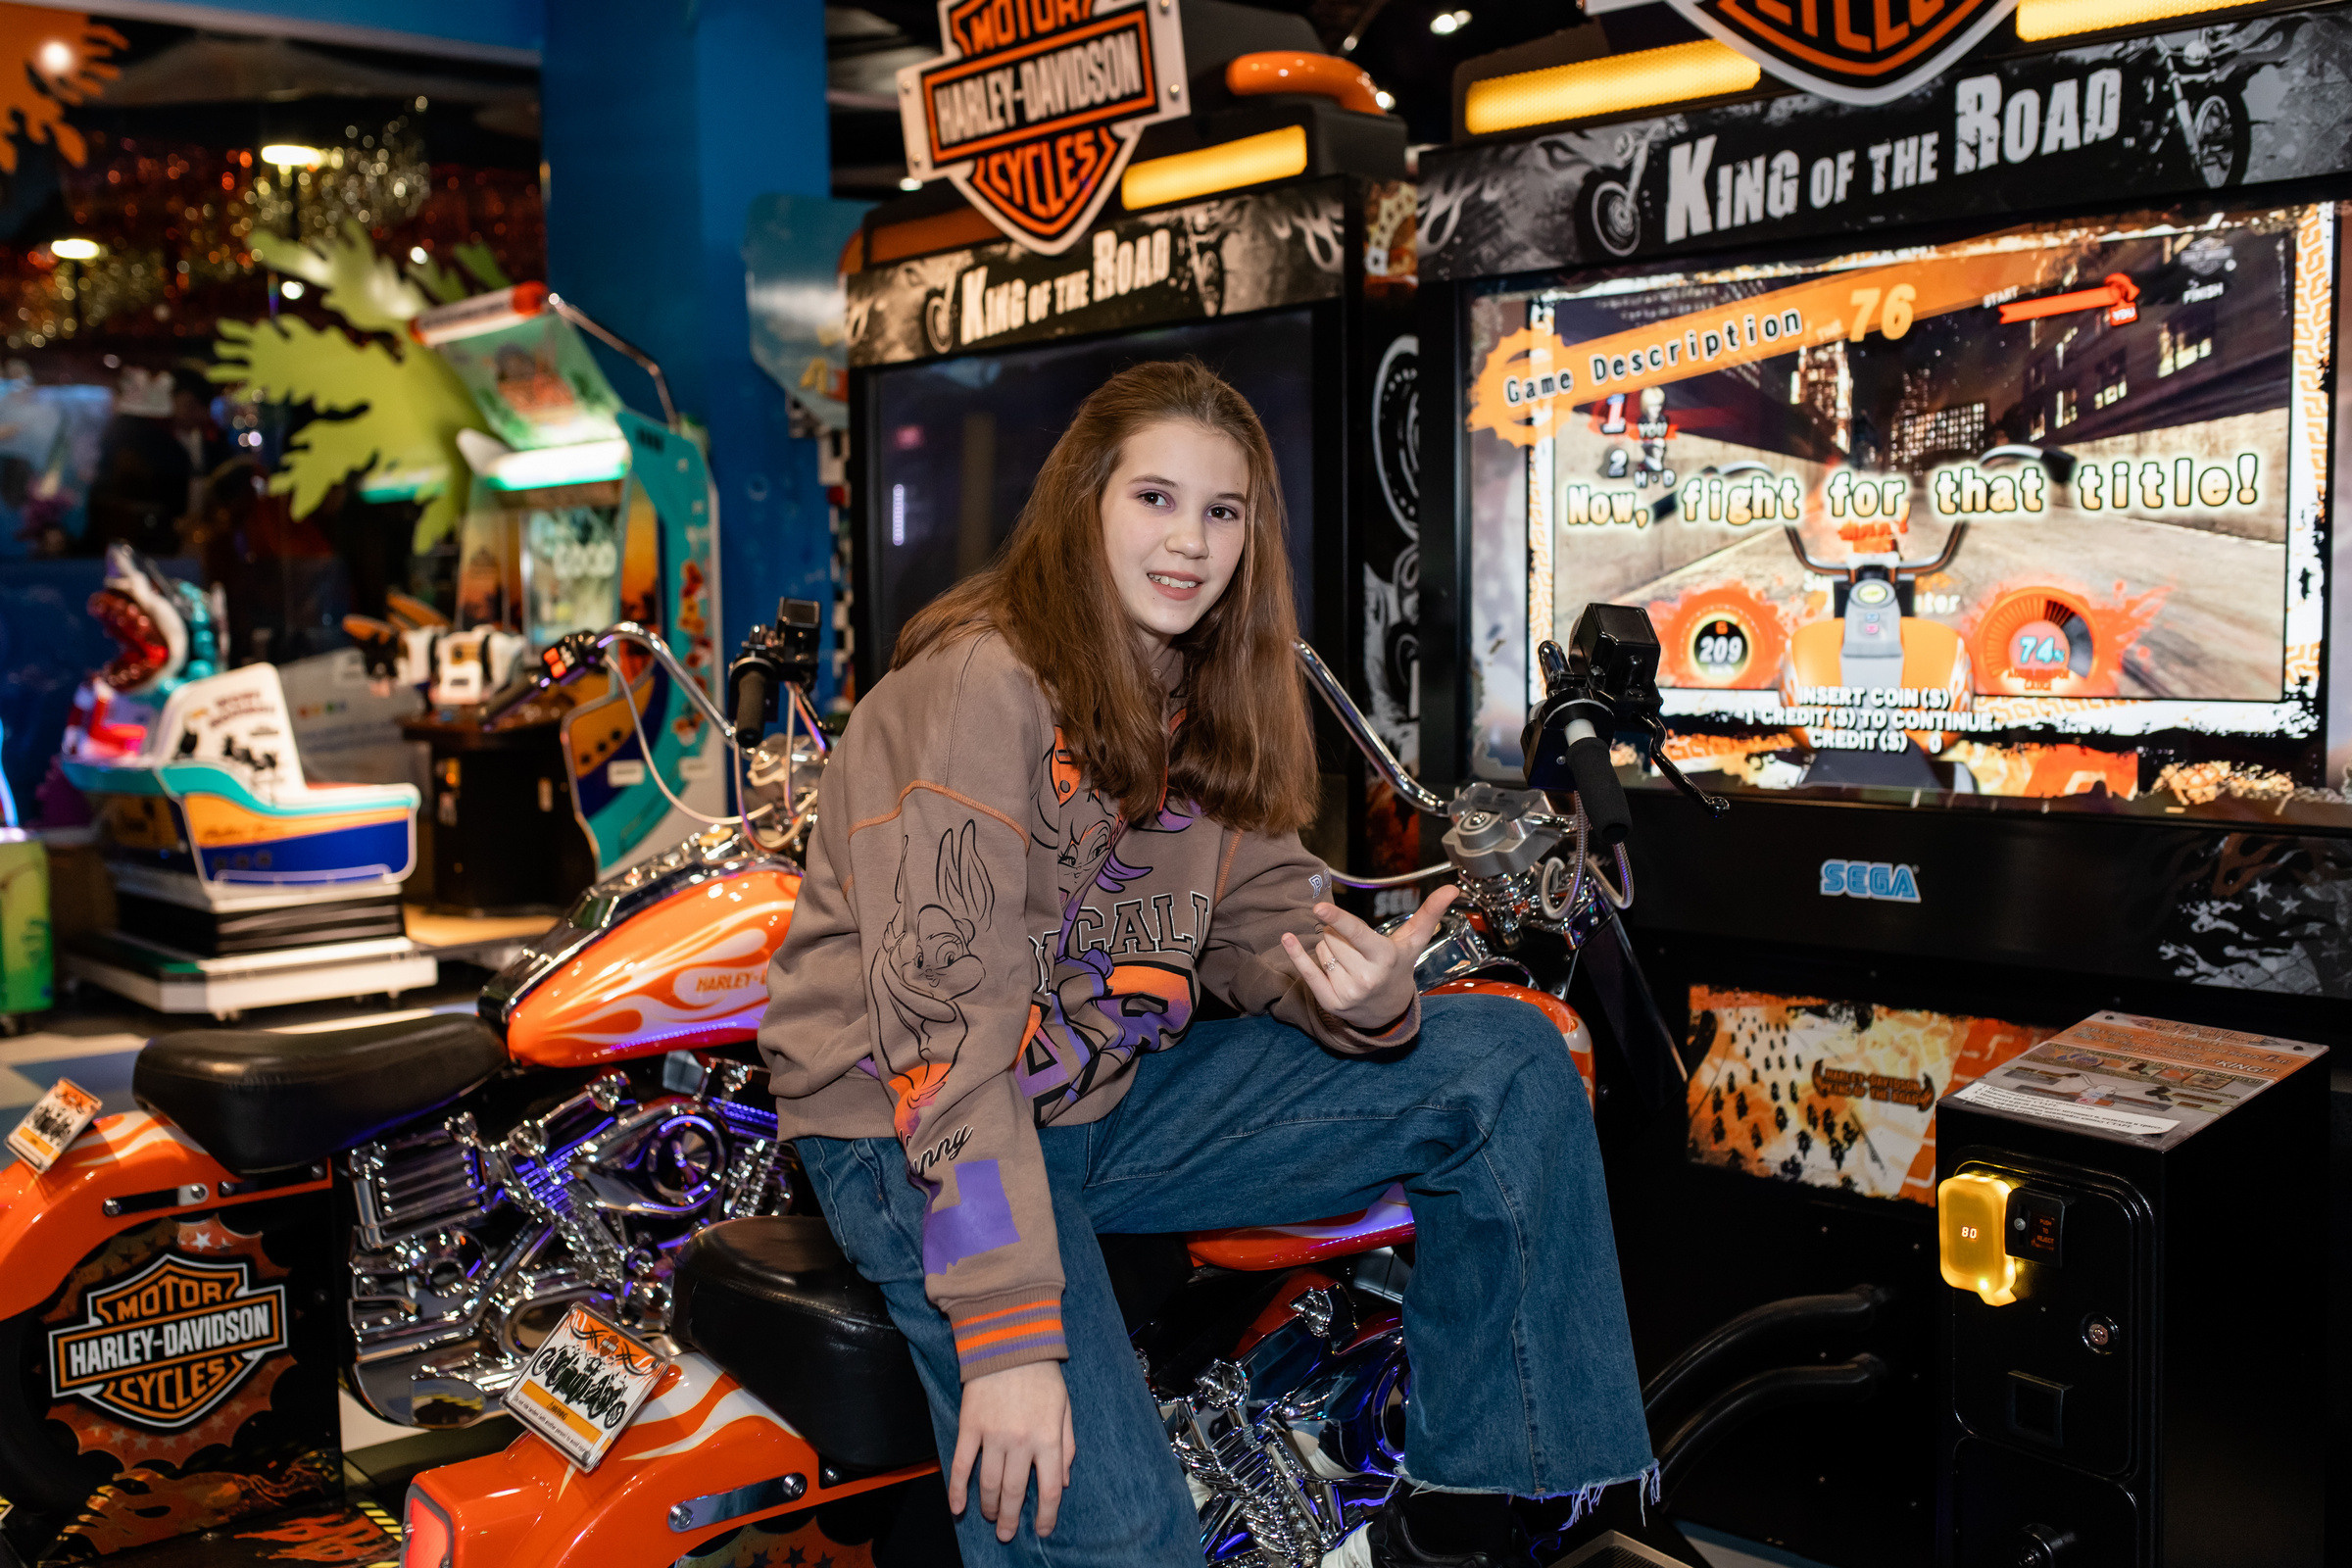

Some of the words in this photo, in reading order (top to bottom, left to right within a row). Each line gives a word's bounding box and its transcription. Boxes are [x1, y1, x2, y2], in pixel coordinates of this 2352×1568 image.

[934, 30, 1143, 145] HARLEY-DAVIDSON
[988, 129, 1098, 218] CYCLES
[1665, 134, 1800, 244] KING
[1809, 150, 1856, 209] OF
[1868, 131, 1939, 195] THE
[1955, 68, 2123, 175] ROAD
[960, 266, 1027, 346] KING
[1028, 280, 1052, 323] OF
[1054, 270, 1090, 315] THE
[1093, 228, 1171, 303] ROAD
[1505, 368, 1573, 406] Game
[1592, 310, 1801, 382] Description
[1847, 283, 1917, 342] 76
[1600, 393, 1626, 434] 1
[1607, 449, 1629, 478] 2
[1568, 485, 1648, 528] Now,
[1683, 476, 1800, 525] fight
[1829, 471, 1906, 517] for
[1936, 467, 2044, 514] that
[2078, 453, 2258, 511] title!
[1699, 636, 1742, 663] 209
[1798, 686, 1866, 708] INSERT
[1861, 709, 1889, 729] TO
[1820, 858, 1922, 904] SEGA
[1961, 1226, 1978, 1240] 80
[116, 1274, 223, 1322] MOTOR
[70, 1303, 270, 1377] HARLEY-DAVIDSON
[120, 1357, 226, 1410] CYCLES
